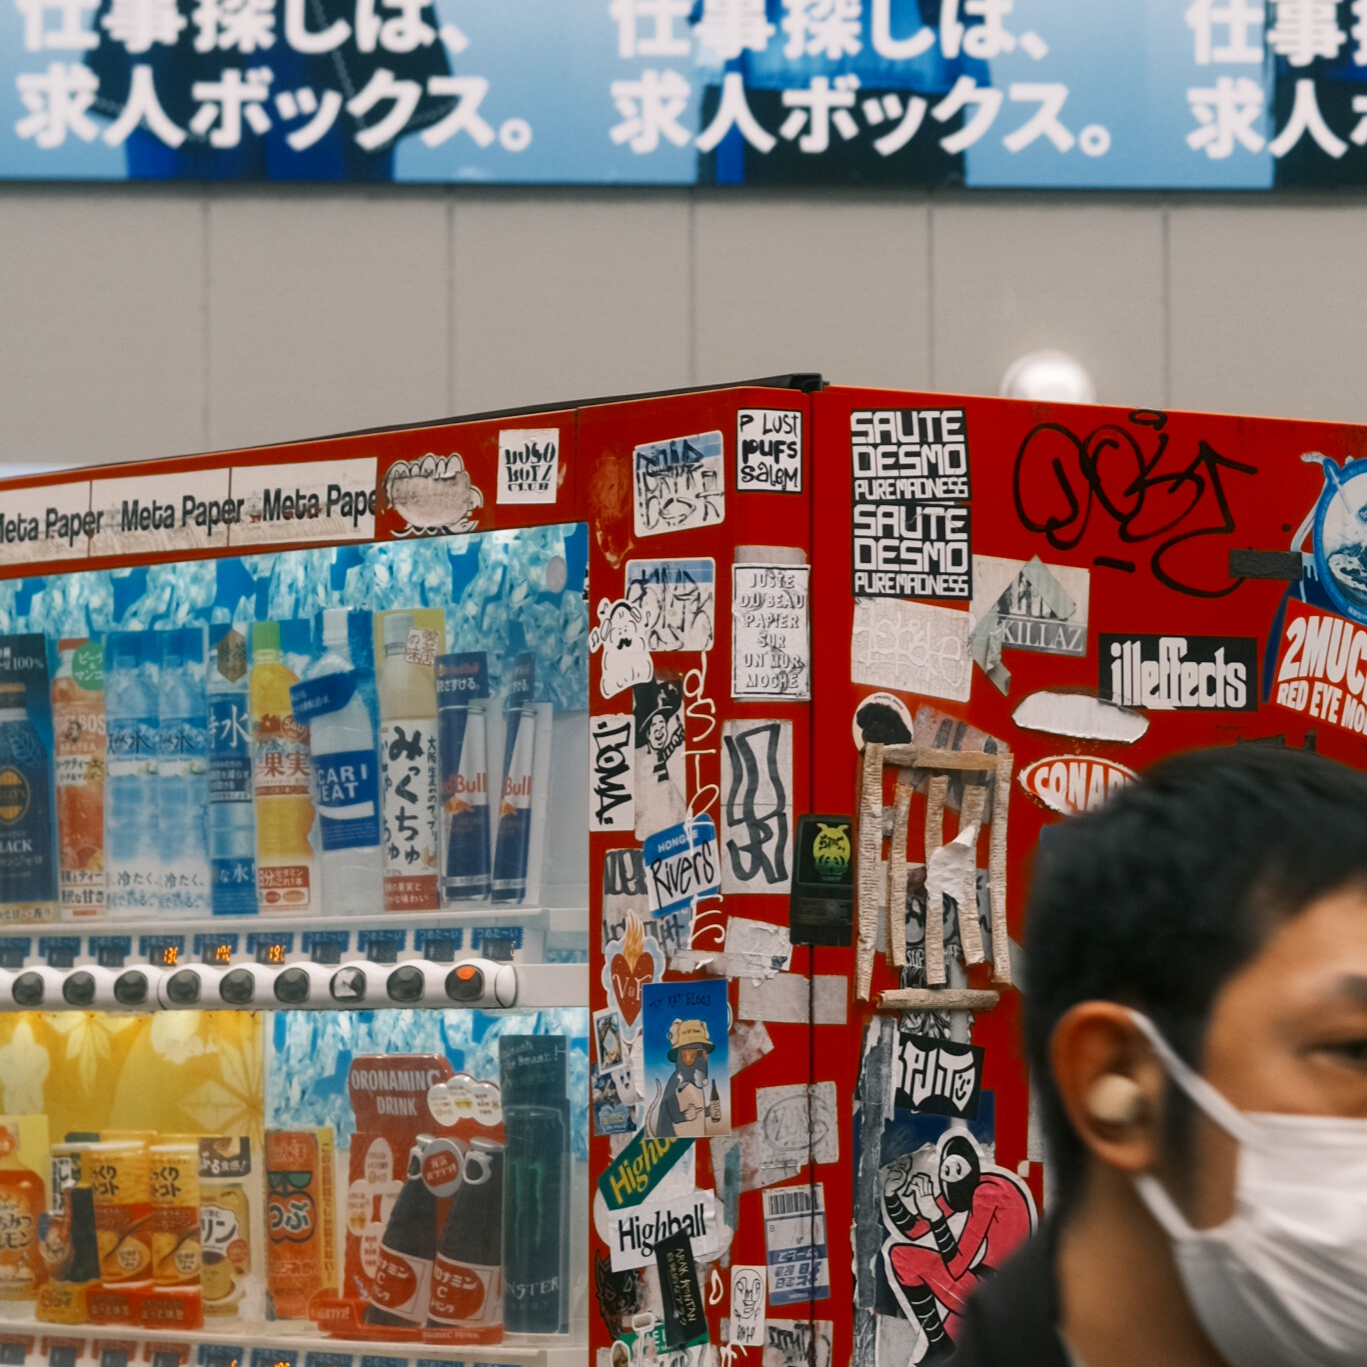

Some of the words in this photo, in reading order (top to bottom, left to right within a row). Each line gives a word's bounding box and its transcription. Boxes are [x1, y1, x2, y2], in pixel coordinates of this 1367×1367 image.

[15, 62, 532, 152] 求人ボックス。
[609, 68, 1112, 157] 求人ボックス。
[850, 410, 965, 444] SAUTE
[852, 443, 968, 478] DESMO
[46, 508, 104, 547] Paper
[121, 499, 175, 532] Meta
[182, 494, 245, 537] Paper
[262, 488, 320, 522] Meta
[854, 504, 969, 540] SAUTE
[854, 538, 969, 574] DESMO
[999, 617, 1083, 652] KILLAZ
[1110, 636, 1248, 710] illeffects
[1276, 682, 1310, 711] RED
[1309, 684, 1343, 725] EYE
[351, 1070, 427, 1092] ORONAMIN
[376, 1096, 418, 1116] DRINK
